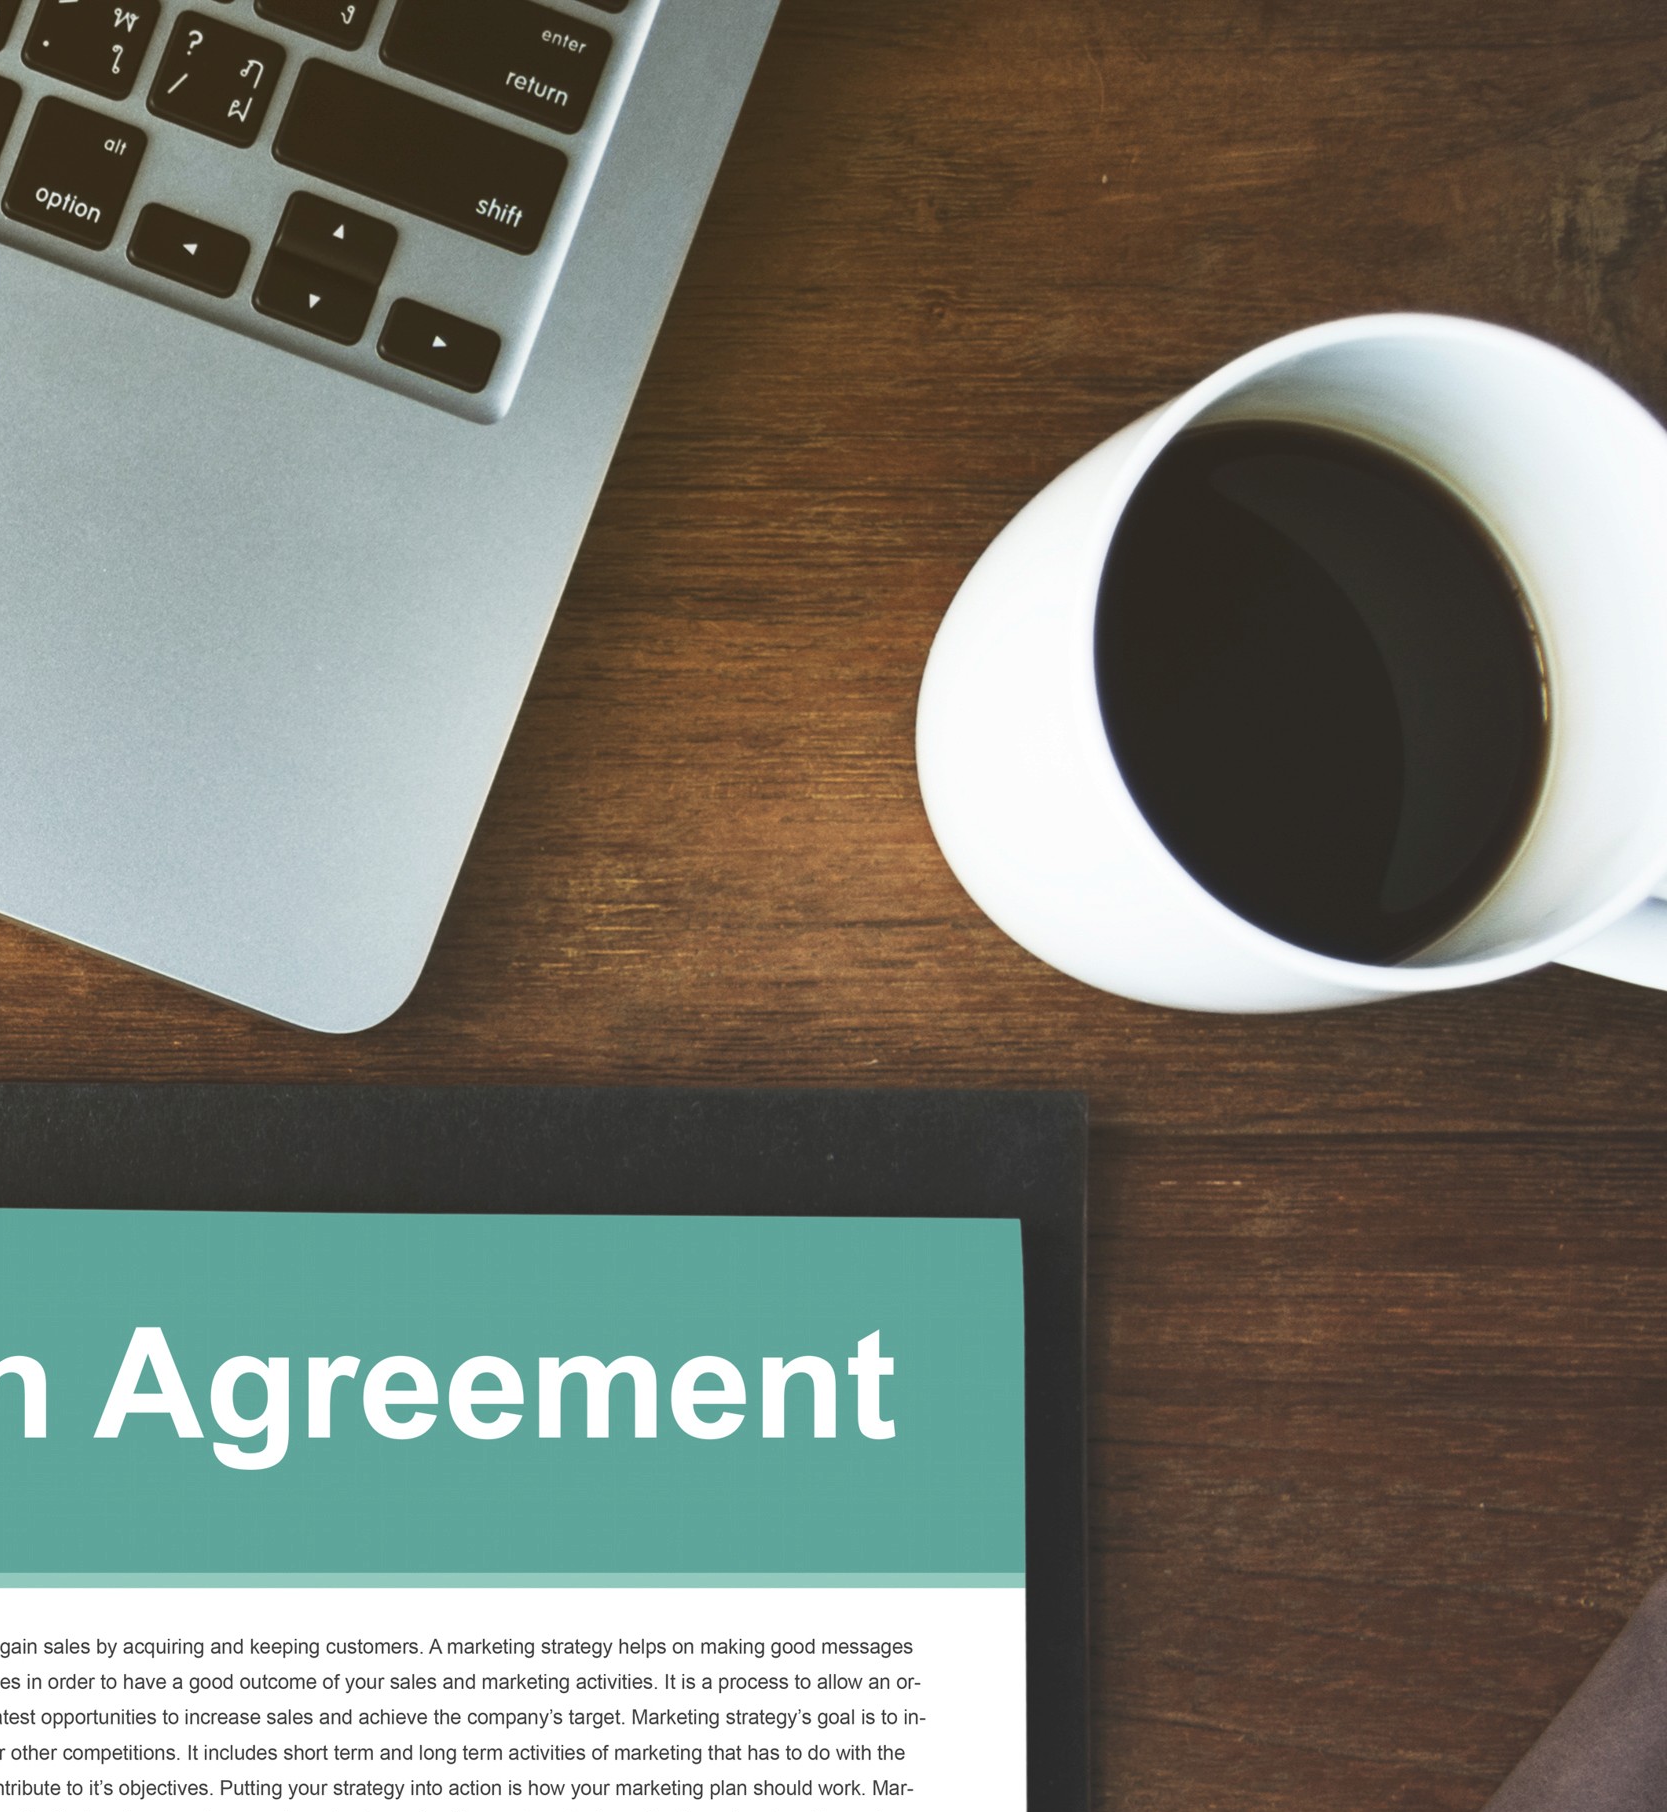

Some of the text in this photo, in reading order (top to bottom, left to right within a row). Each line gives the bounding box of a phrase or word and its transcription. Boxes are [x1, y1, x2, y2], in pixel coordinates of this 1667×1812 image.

[541, 30, 587, 53] enter
[505, 71, 568, 106] return
[104, 139, 127, 155] alt
[35, 187, 101, 223] option
[475, 198, 523, 228] shift
[94, 1327, 895, 1470] Agreement
[0, 1639, 36, 1658] gain
[44, 1639, 90, 1654] sales
[97, 1639, 117, 1658] by
[124, 1639, 203, 1658] acquiring
[211, 1639, 243, 1654] and
[251, 1639, 319, 1658] keeping
[327, 1640, 422, 1654] customers.
[429, 1639, 442, 1654] A
[448, 1639, 534, 1658] marketing
[542, 1639, 612, 1658] strategy
[620, 1639, 666, 1658] helps
[673, 1642, 693, 1654] on
[702, 1639, 764, 1658] making
[771, 1639, 814, 1658] good
[822, 1642, 912, 1658] messages
